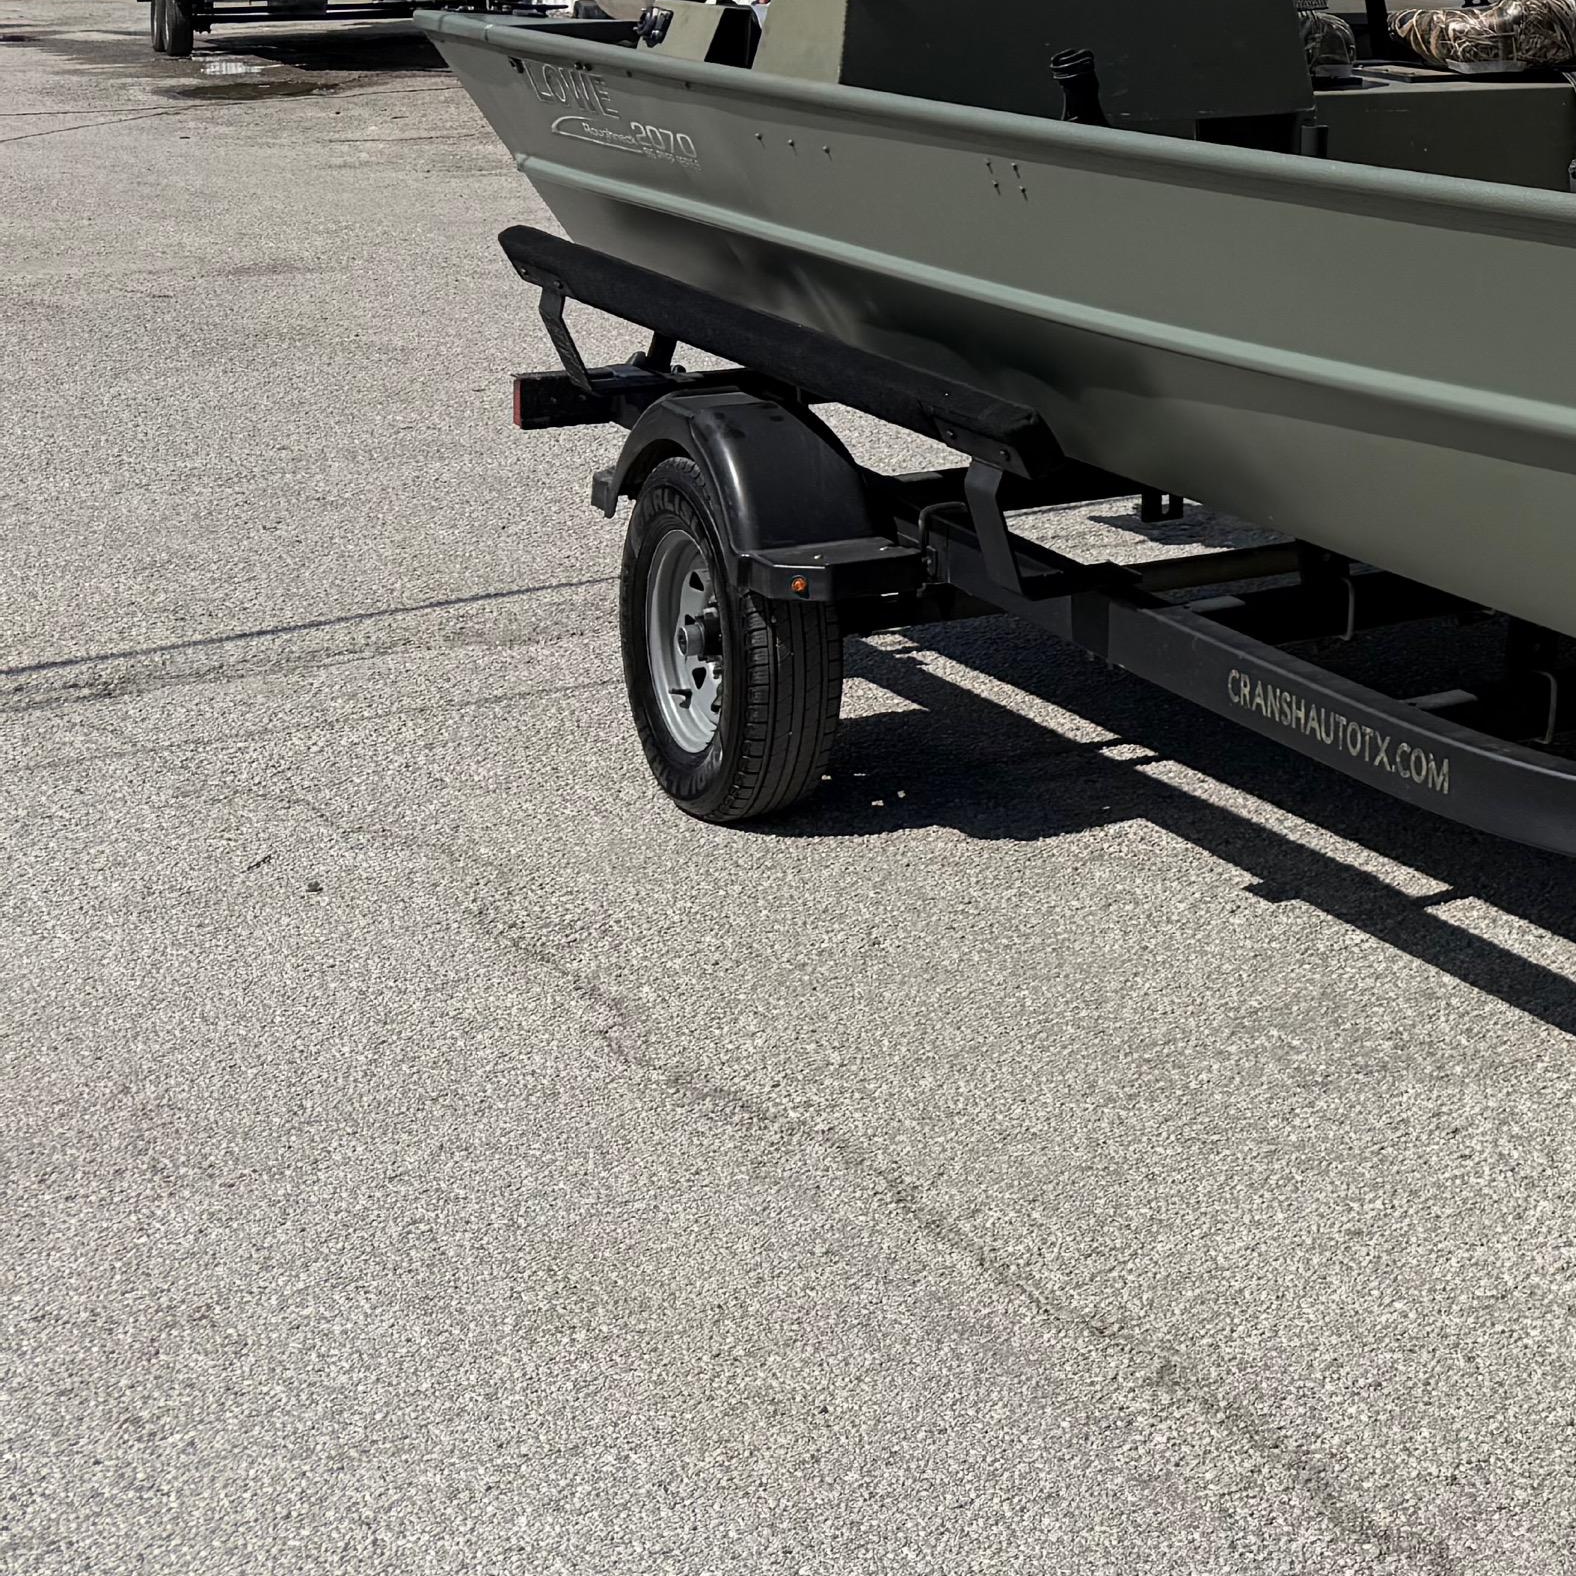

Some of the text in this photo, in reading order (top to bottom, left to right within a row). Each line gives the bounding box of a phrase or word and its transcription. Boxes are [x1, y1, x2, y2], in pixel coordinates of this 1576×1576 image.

[522, 58, 620, 120] LOWE
[631, 121, 697, 159] 2070
[1227, 669, 1449, 795] CRANSHAUTOTX.COM
